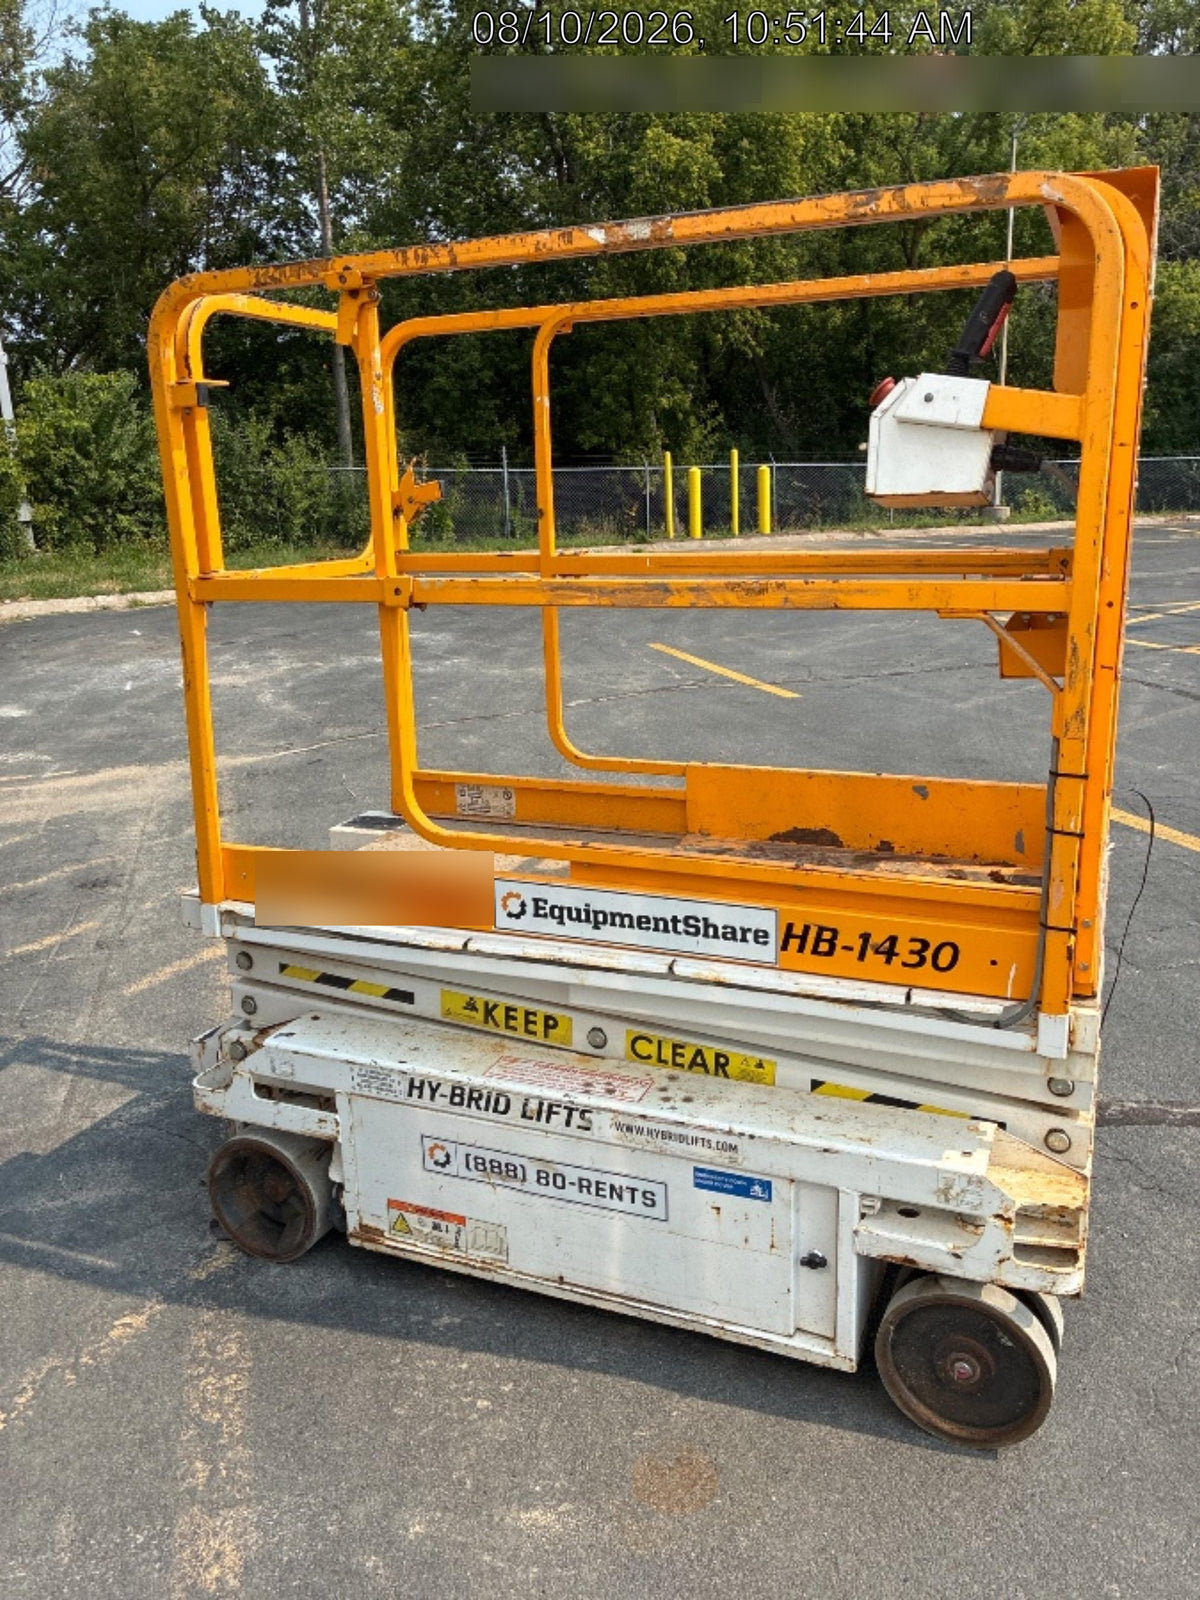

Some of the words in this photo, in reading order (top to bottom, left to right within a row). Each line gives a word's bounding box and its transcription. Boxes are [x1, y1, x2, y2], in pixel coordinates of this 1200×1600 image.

[531, 897, 770, 946] EquipmentShare
[780, 922, 961, 974] HB-1430
[482, 1001, 560, 1040] KEEP
[630, 1034, 730, 1080] CLEAR
[405, 1077, 511, 1117] HY-BRID
[520, 1097, 594, 1132] LIFTS
[613, 1120, 739, 1154] WWW.HYBRIDLIFTS.COM
[464, 1152, 527, 1184] (888)
[535, 1168, 657, 1209] 80-RENTS
